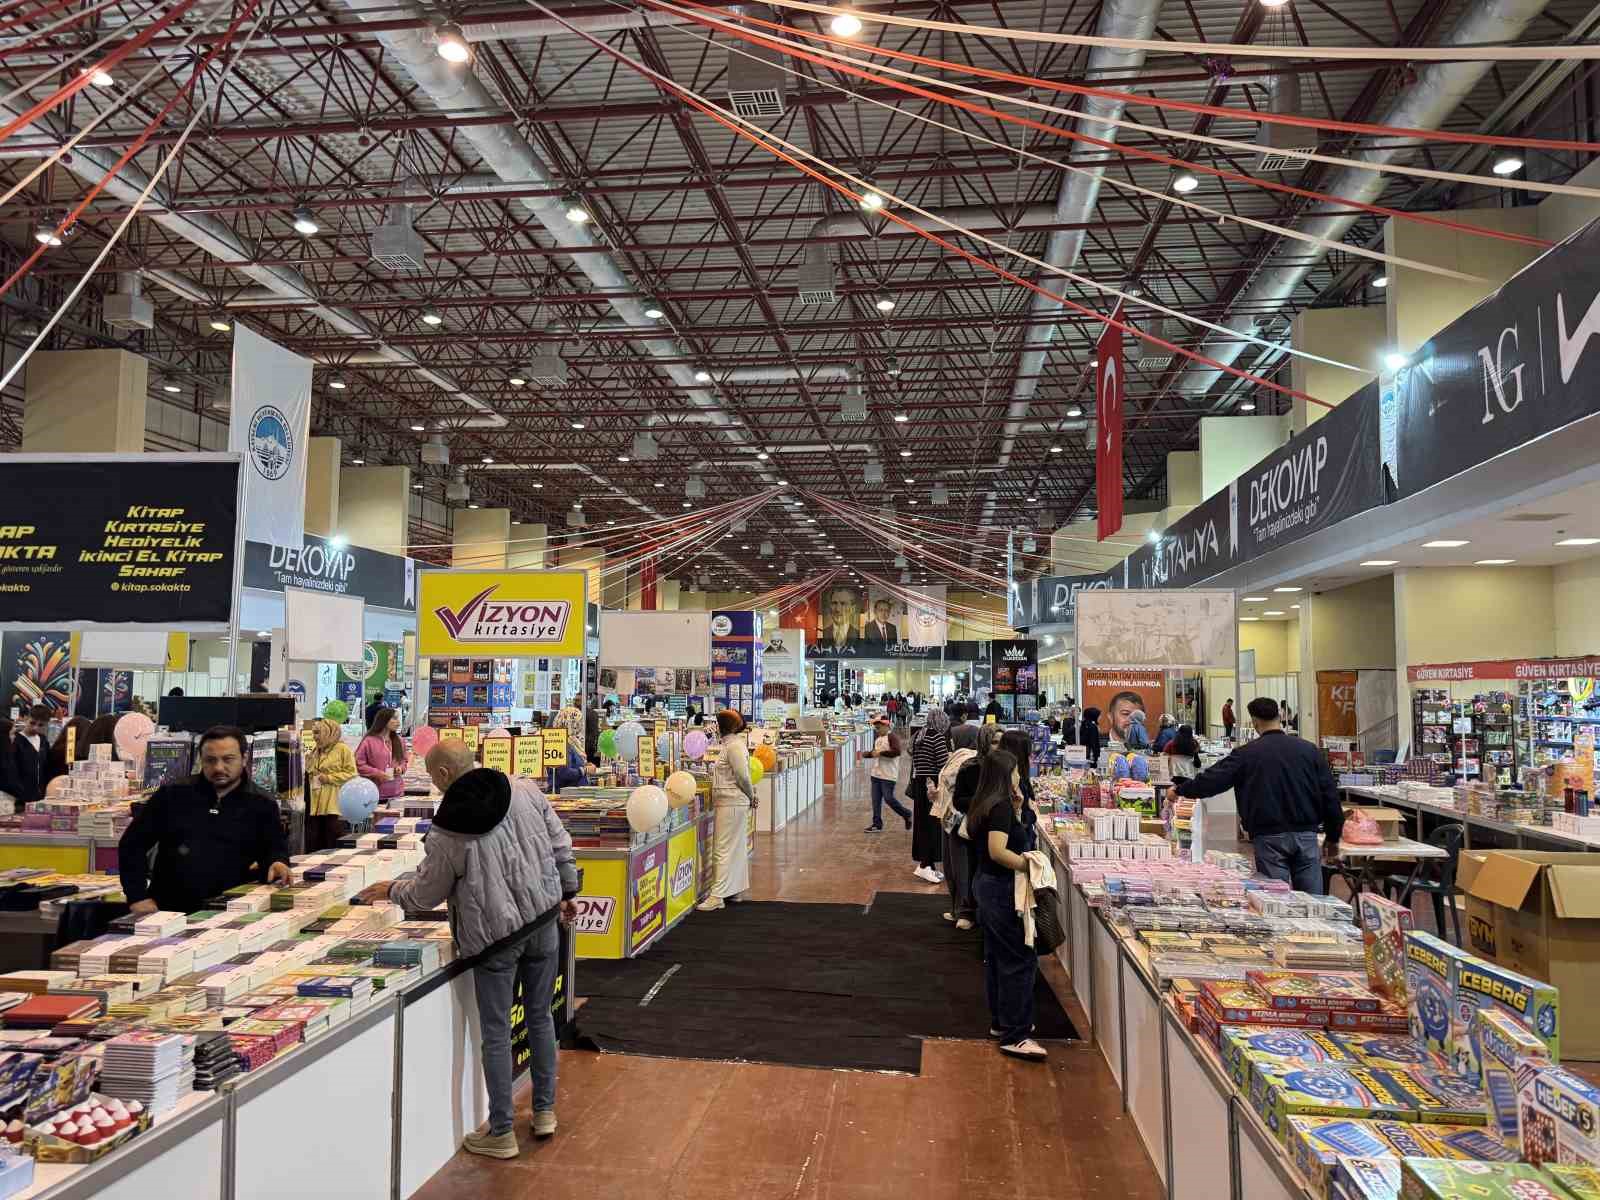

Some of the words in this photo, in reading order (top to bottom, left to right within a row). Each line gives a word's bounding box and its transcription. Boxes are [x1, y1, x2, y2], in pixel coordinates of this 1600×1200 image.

[1250, 436, 1328, 526] DEKOYAP
[165, 550, 224, 562] KİTAP
[118, 565, 186, 577] SAHAF
[475, 623, 556, 638] kırtasiye
[1515, 663, 1546, 677] GÜVEN
[1407, 943, 1449, 977] ICEBERG
[1458, 970, 1528, 1012] ICEBERG
